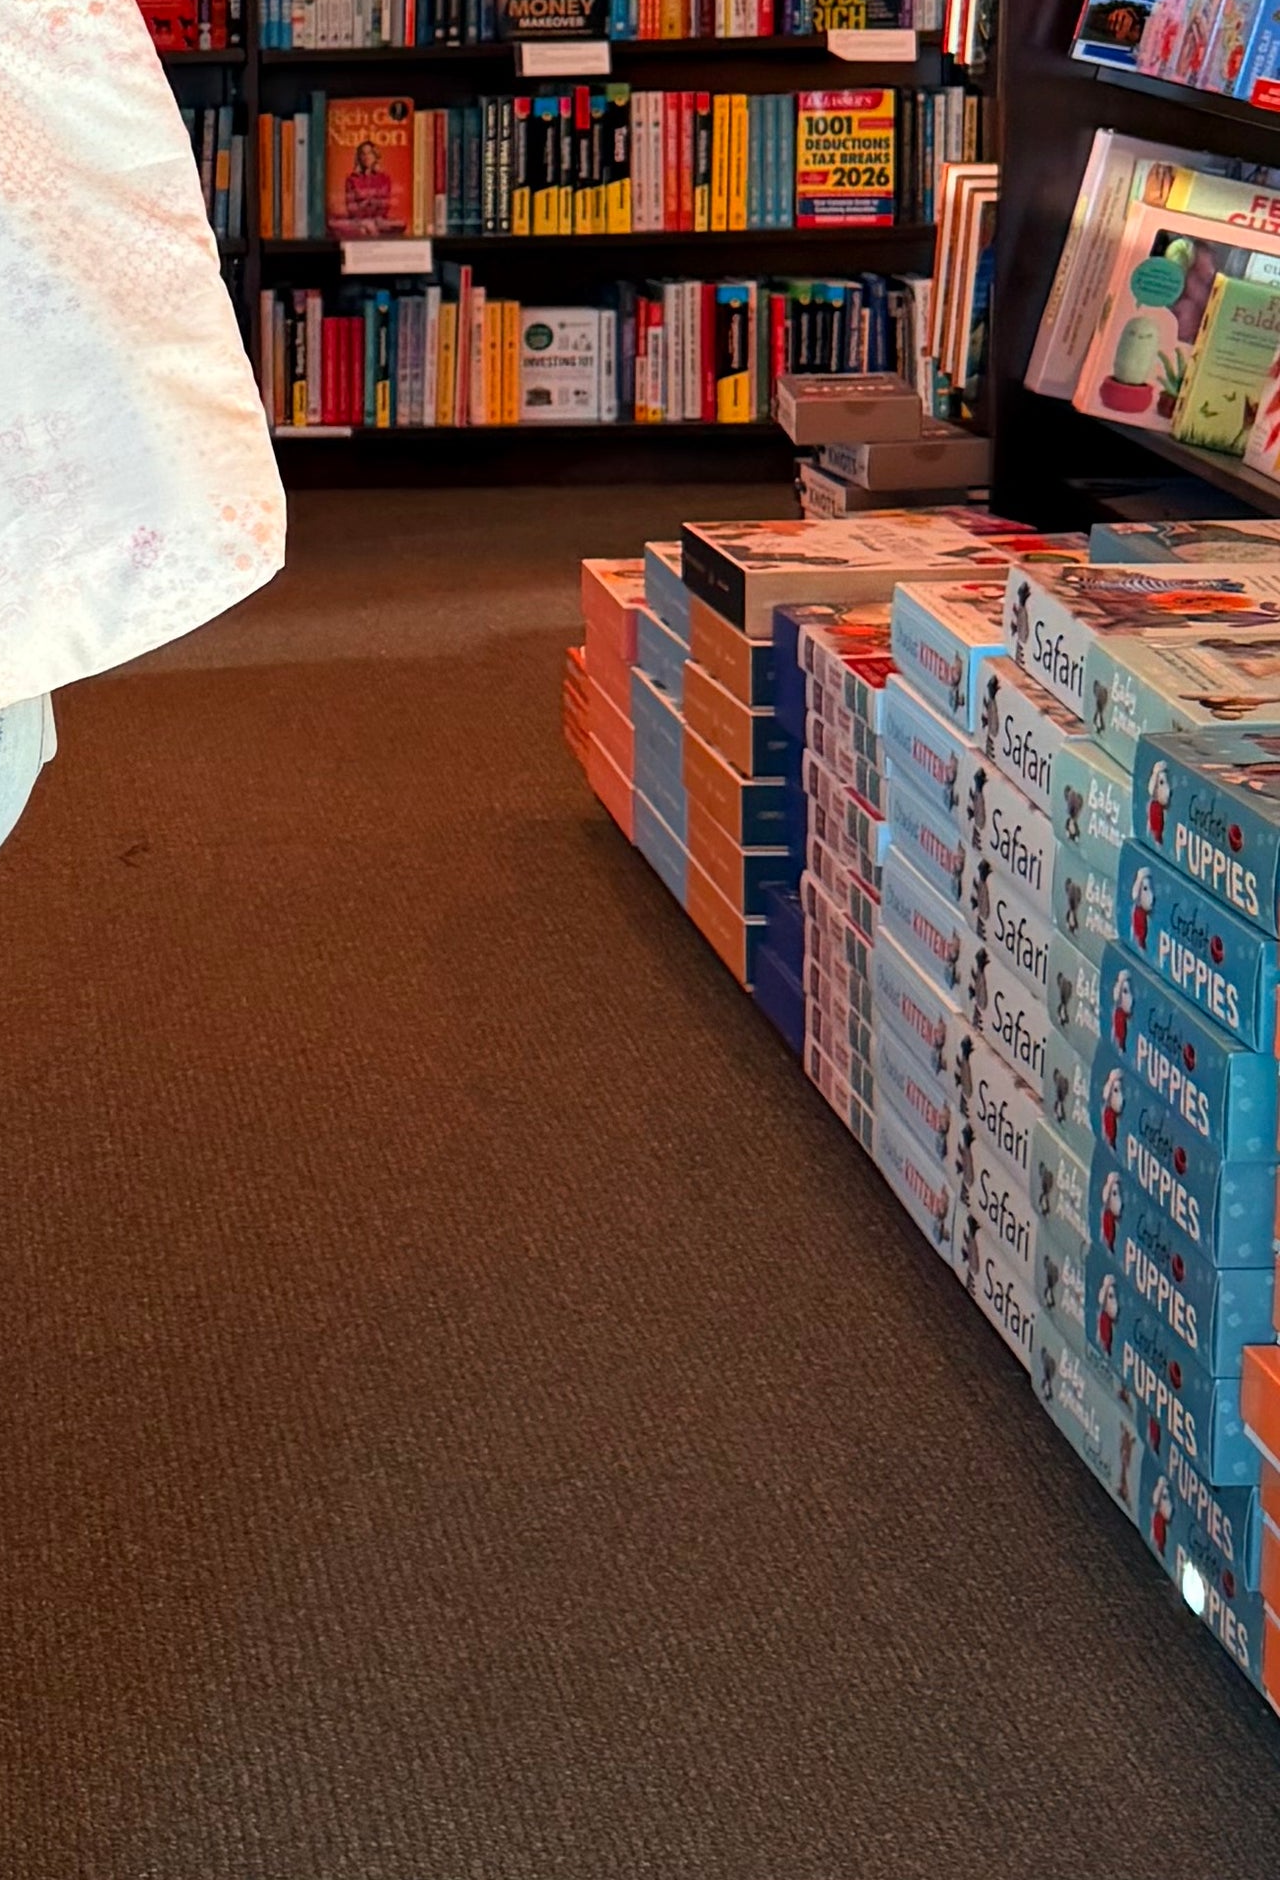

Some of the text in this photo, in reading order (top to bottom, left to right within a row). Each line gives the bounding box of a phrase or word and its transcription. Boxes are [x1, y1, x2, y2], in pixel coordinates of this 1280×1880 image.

[805, 138, 890, 151] DEDUCTIONS
[806, 117, 853, 135] 1001
[811, 152, 890, 165] TAX BREAKS
[832, 168, 890, 187] 2026
[1033, 621, 1085, 698] Safari
[1111, 673, 1137, 715] Baby
[1003, 715, 1052, 796] Safari
[1087, 779, 1122, 820] Baby
[990, 810, 1042, 890] Safari
[1175, 822, 1259, 917] PUPPIES
[995, 900, 1049, 986] Safari
[1158, 930, 1240, 1026] PUPPIES
[1136, 1032, 1210, 1138] PUPPIES
